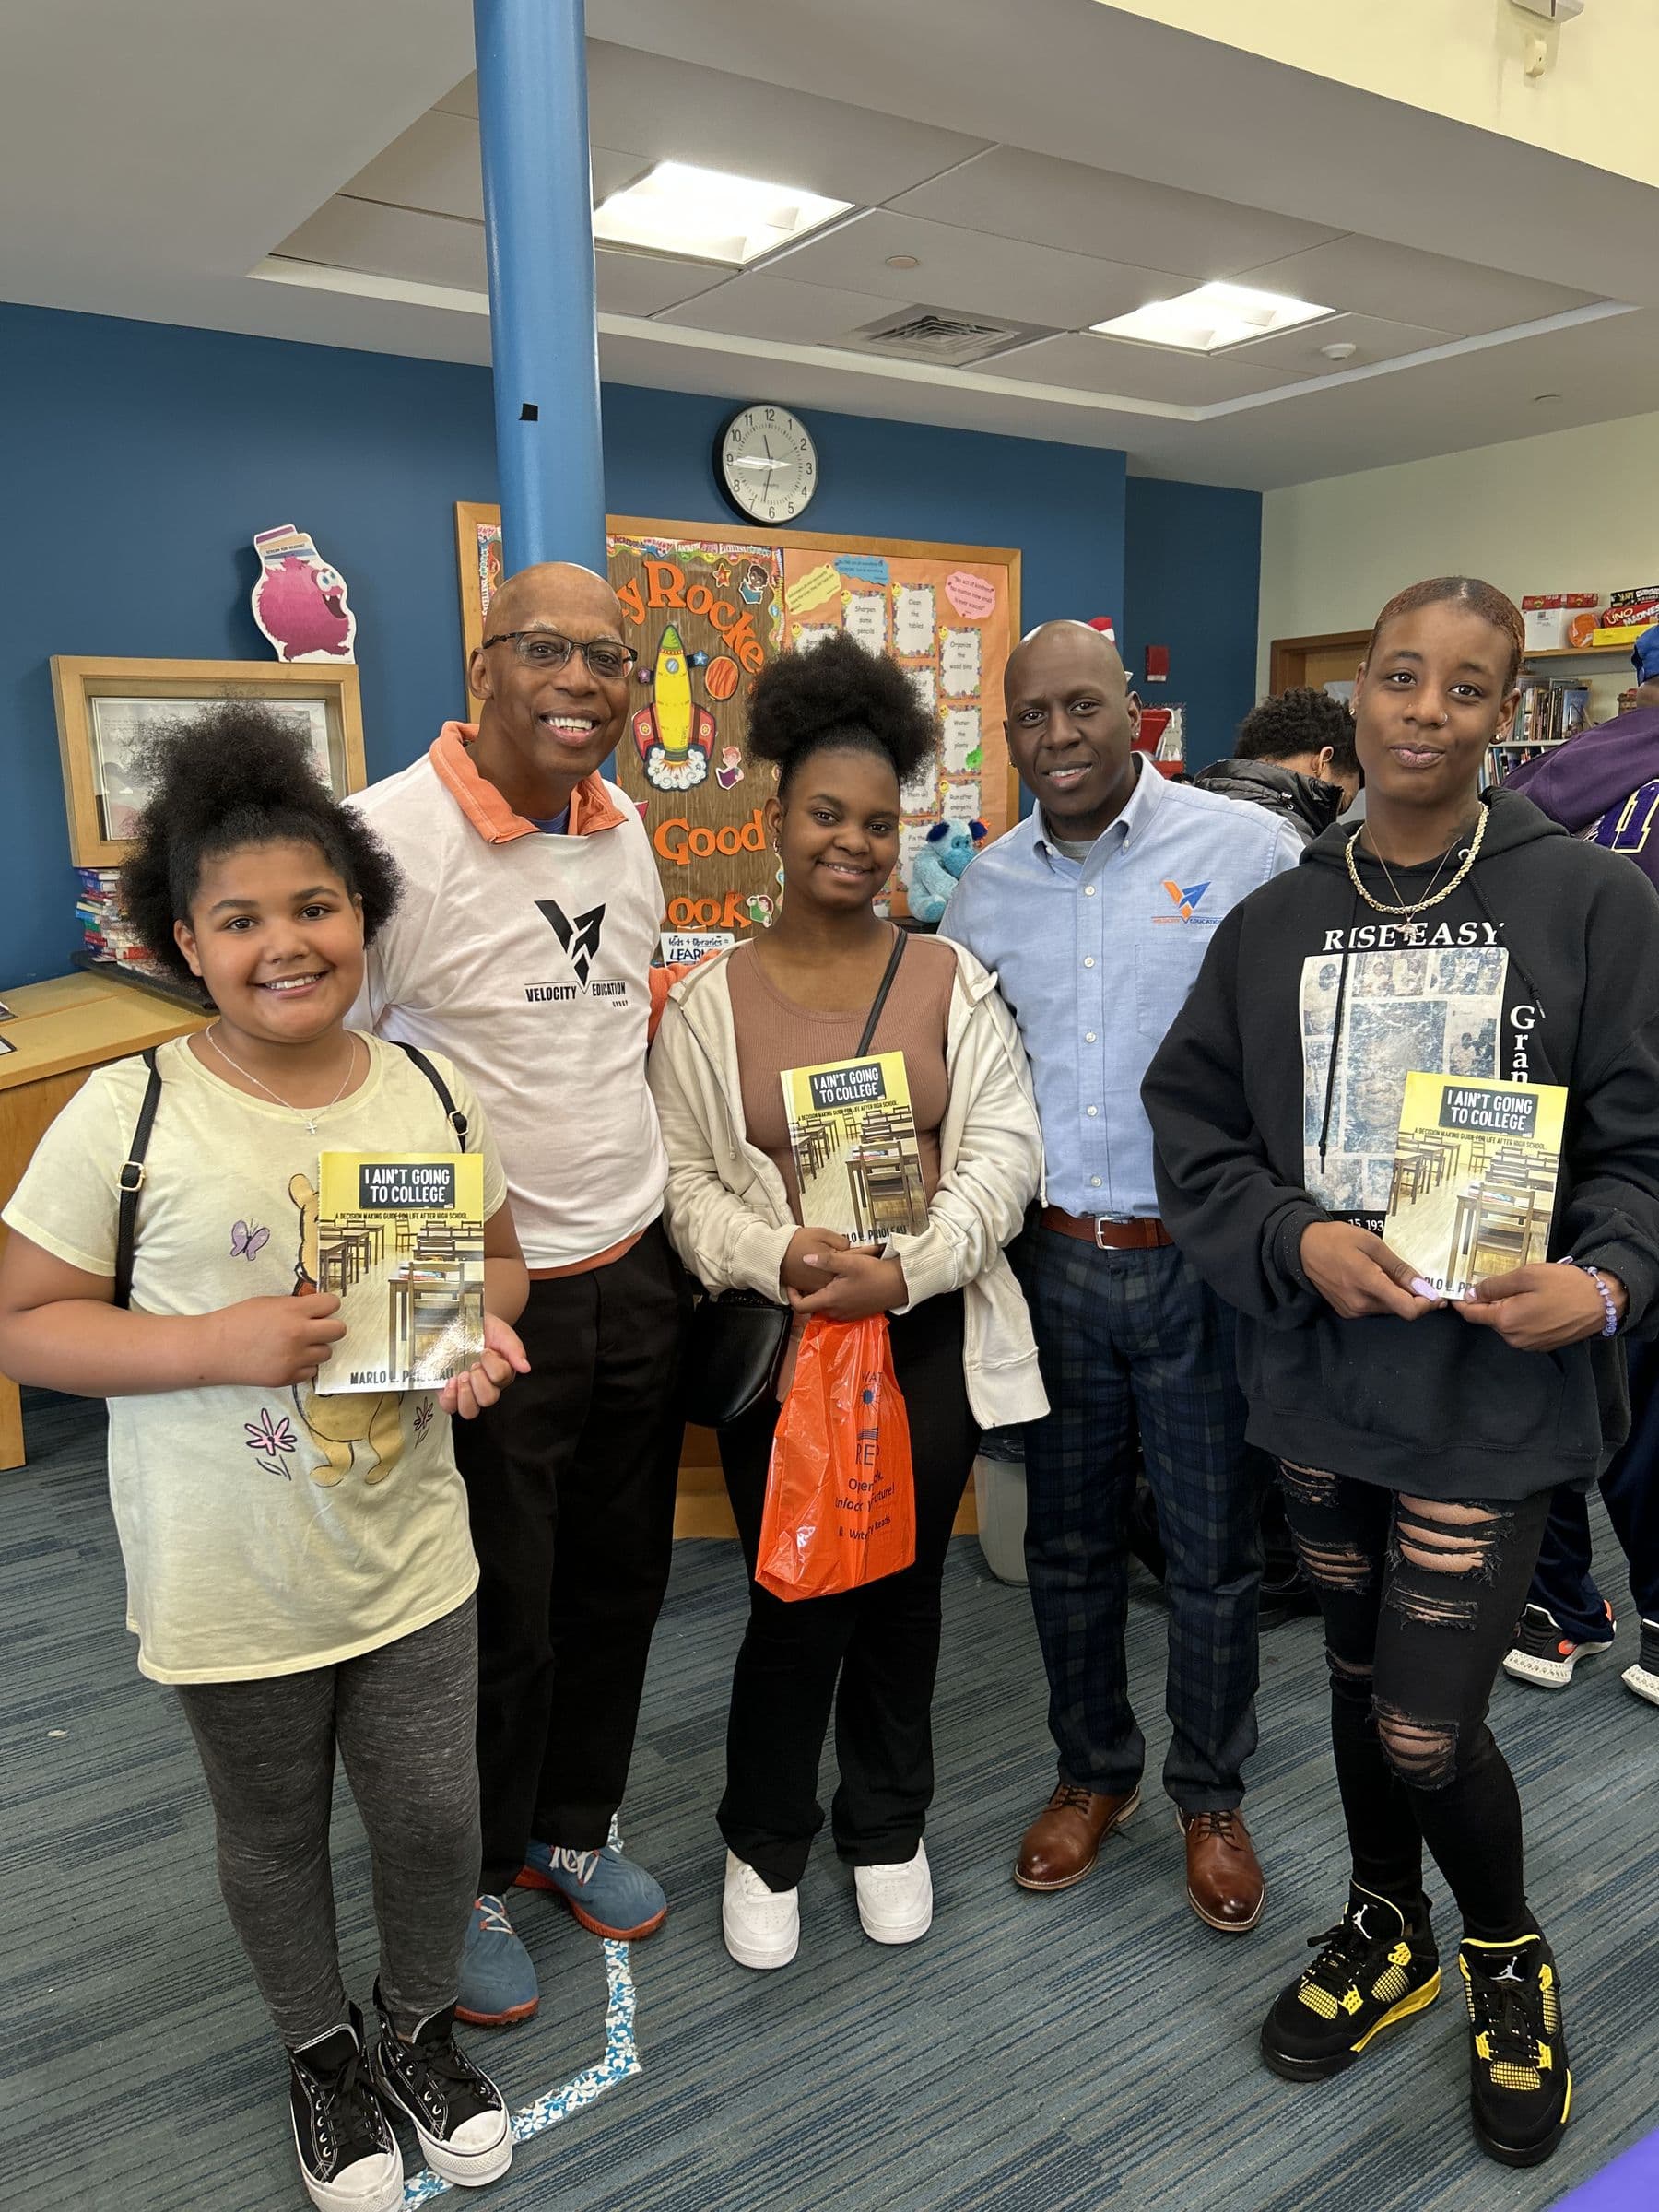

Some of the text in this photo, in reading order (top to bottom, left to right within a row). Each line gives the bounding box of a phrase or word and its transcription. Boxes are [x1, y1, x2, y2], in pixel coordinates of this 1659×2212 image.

[745, 413, 753, 426] 11
[765, 408, 775, 421] 12
[788, 418, 793, 430] 1
[731, 429, 742, 442] 10
[800, 438, 806, 451] 2
[726, 453, 734, 466] 9
[806, 462, 812, 475] 3
[733, 479, 740, 492] 8
[801, 486, 807, 498] 4
[748, 499, 755, 511] 7
[787, 502, 794, 514] 5
[769, 506, 775, 519] 6
[642, 560, 764, 675] Rocke
[1606, 608, 1633, 624] UNO
[653, 807, 767, 865] Good
[1322, 921, 1505, 951] RISE EASY
[525, 985, 577, 1002] VELOCITY
[814, 1067, 879, 1090] I AIN'T GOING
[819, 1082, 878, 1104] TO COLLEGE
[1447, 1089, 1533, 1114] I AIN'T GOING
[1451, 1106, 1526, 1131] TO COLLEGE
[1441, 1130, 1460, 1138] MAKING
[1486, 1135, 1496, 1144] LIFE
[365, 1168, 450, 1185] I AIN'T GOING
[370, 1185, 445, 1203] TO COLLEGE
[1365, 1219, 1384, 1231] 193
[350, 1371, 386, 1385] MARLO
[862, 1371, 884, 1382] WAT
